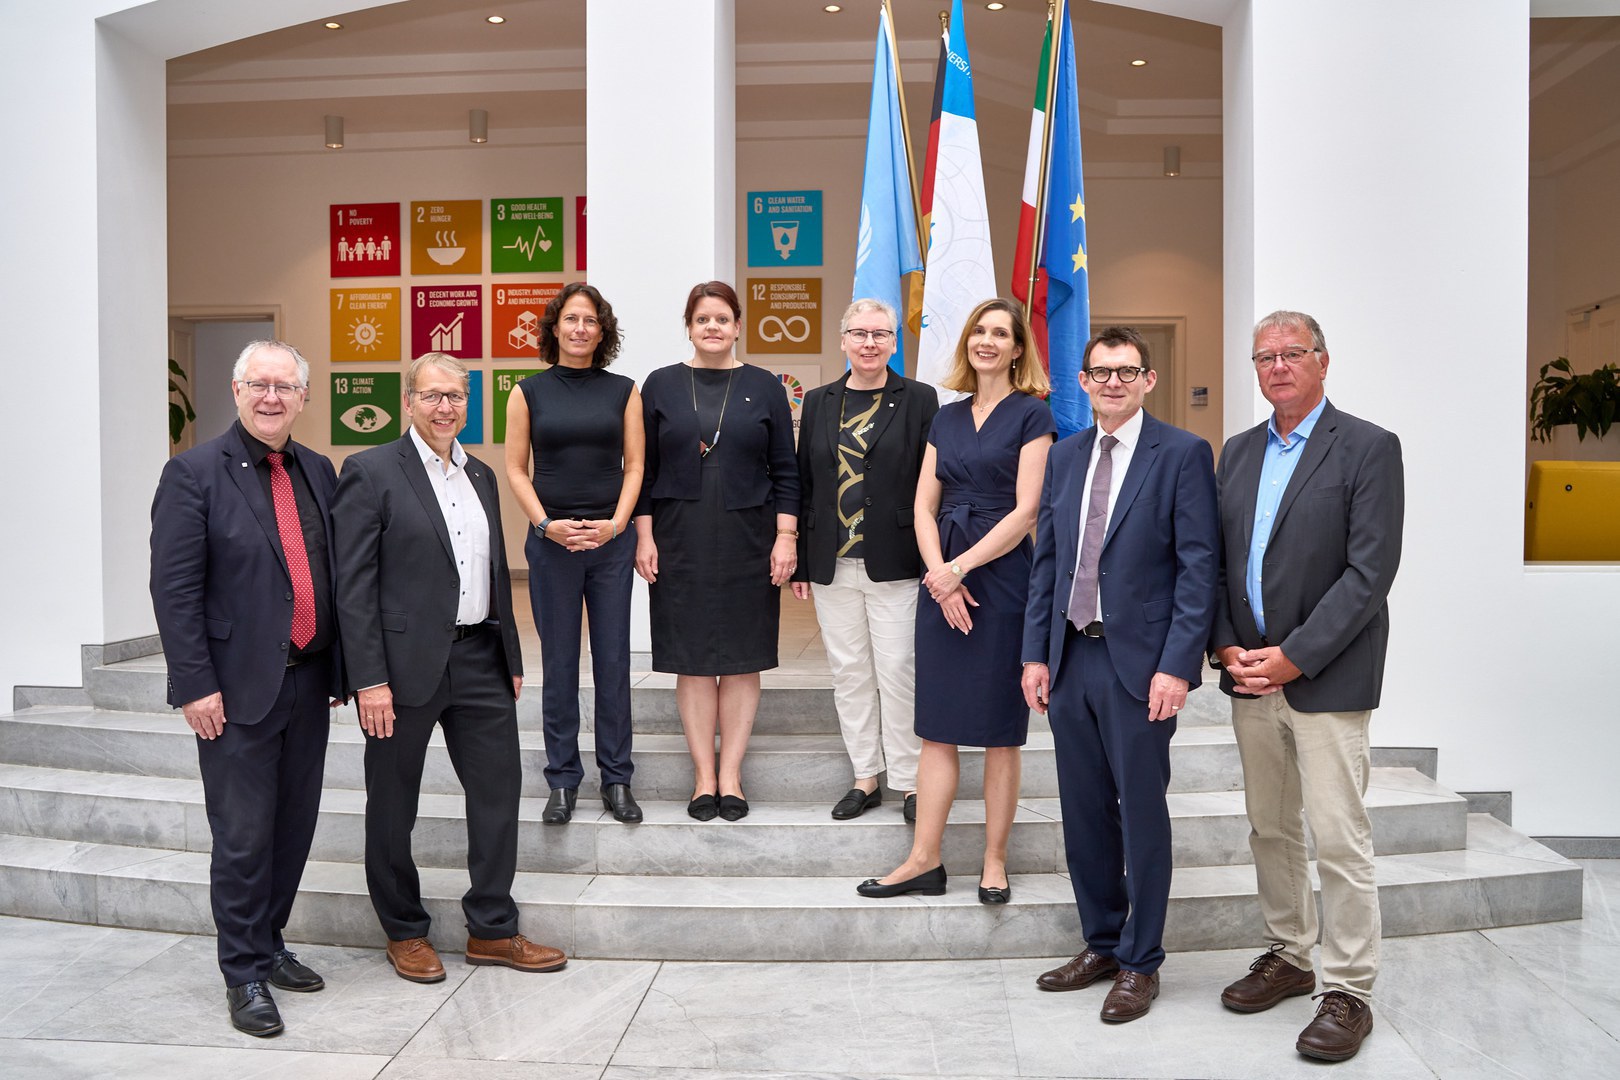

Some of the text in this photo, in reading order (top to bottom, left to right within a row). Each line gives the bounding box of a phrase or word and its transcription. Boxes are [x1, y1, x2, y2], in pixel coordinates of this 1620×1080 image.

[497, 204, 505, 220] 3
[754, 197, 763, 214] 6
[781, 205, 813, 213] SANITATION
[337, 210, 343, 226] 1
[349, 218, 373, 226] POVERTY
[416, 206, 424, 222] 2
[430, 214, 451, 223] HUNGER
[524, 211, 554, 220] WELL-BEING
[350, 293, 381, 301] AFFORDABLE
[417, 291, 425, 307] 8
[497, 289, 505, 305] 9
[752, 284, 766, 301] 12
[337, 294, 344, 310] 7
[367, 301, 387, 309] ENERGY
[429, 298, 478, 307] ECONOMIC GROWTH
[335, 378, 348, 394] 13
[497, 375, 511, 391] 15
